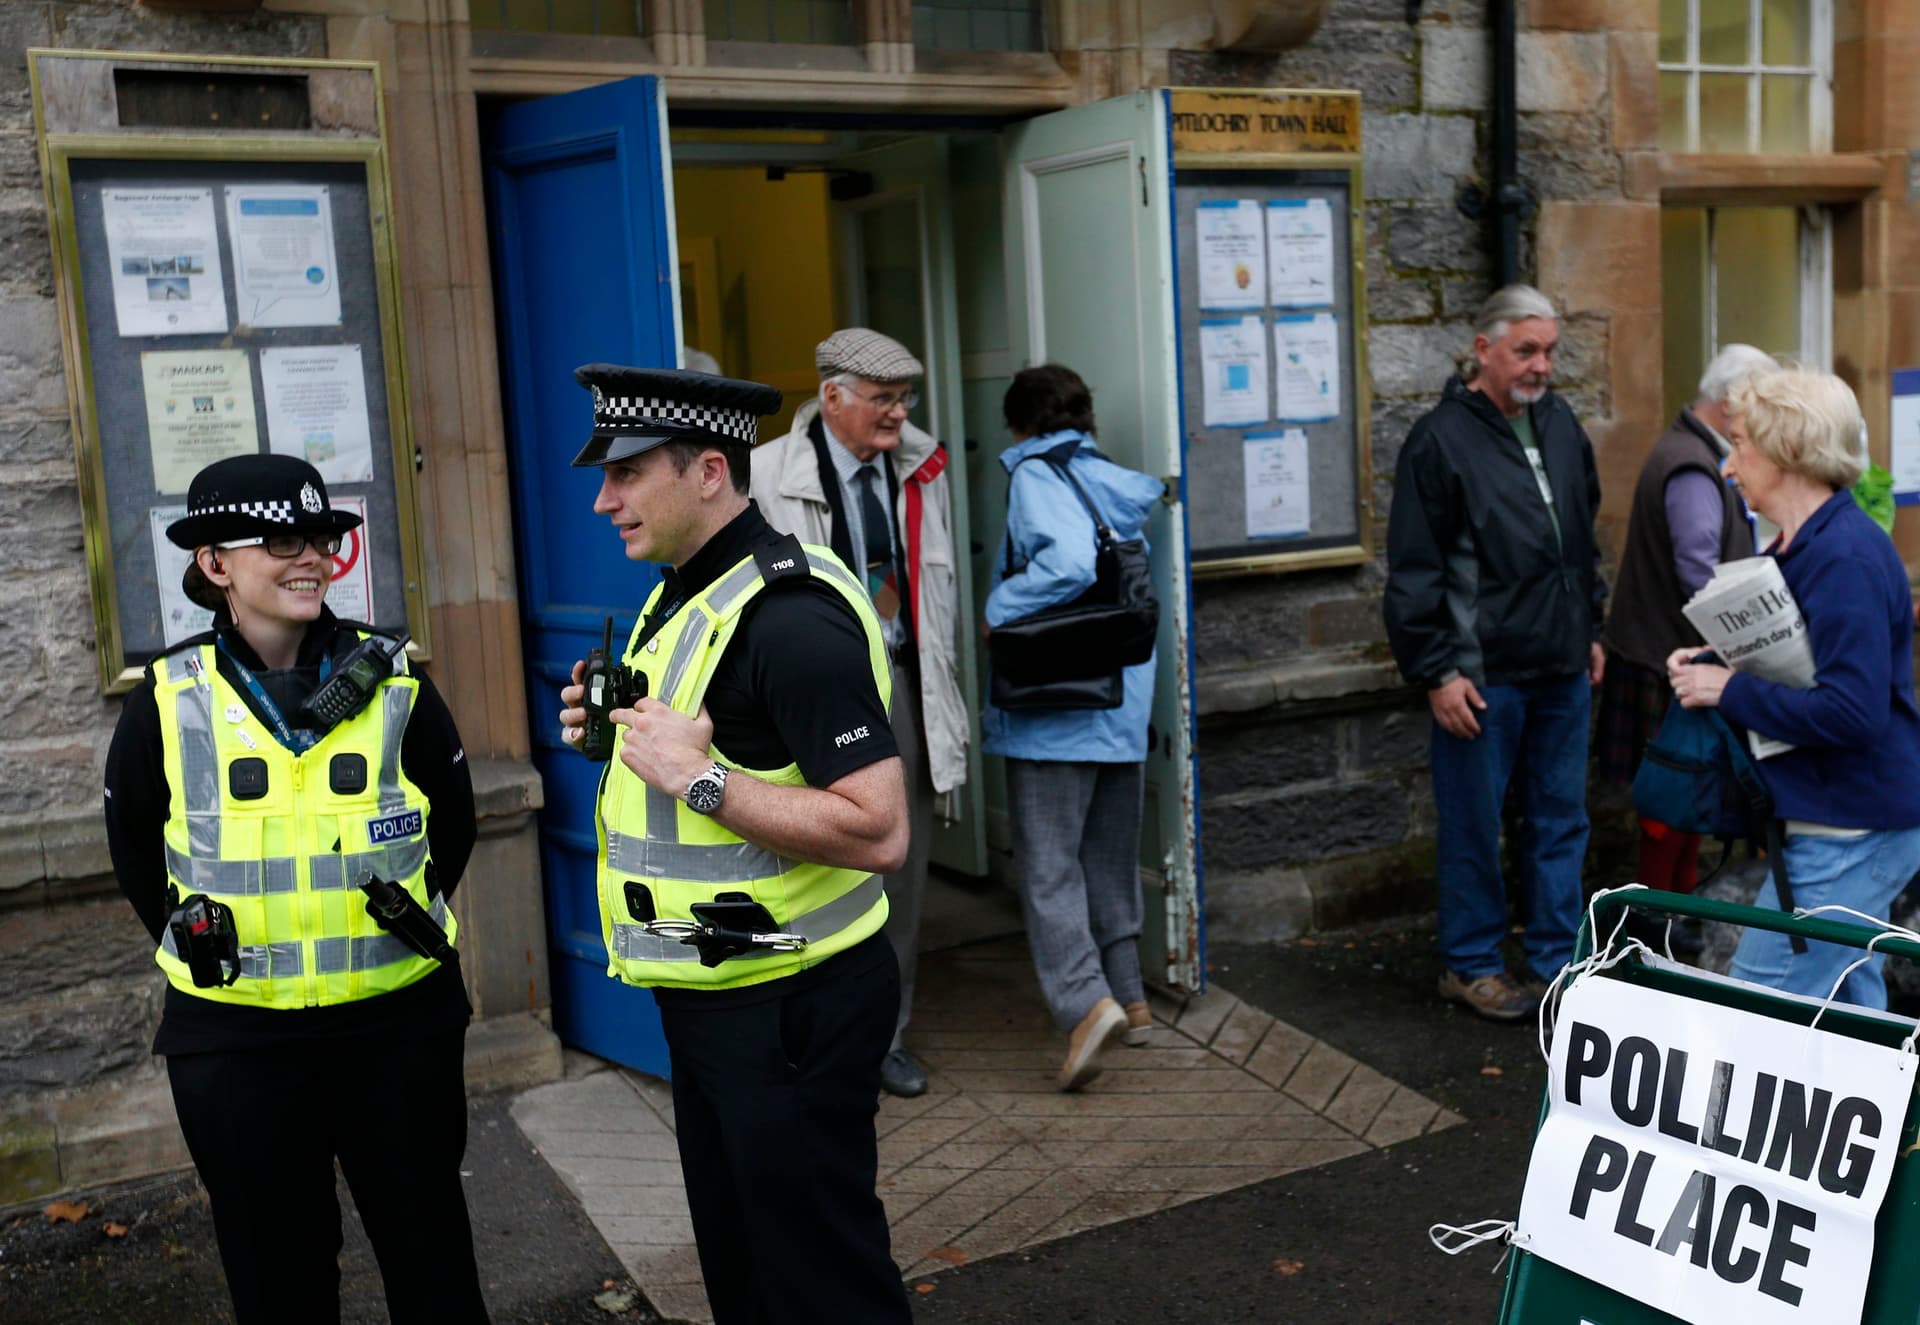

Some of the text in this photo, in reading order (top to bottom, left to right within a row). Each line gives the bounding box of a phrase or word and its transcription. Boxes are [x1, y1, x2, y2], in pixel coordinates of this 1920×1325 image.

[1259, 113, 1307, 134] TOWN
[1312, 114, 1347, 134] HALL
[771, 558, 795, 572] 1108
[1715, 607, 1754, 634] The
[1770, 625, 1793, 643] day
[835, 725, 870, 748] POLICE
[372, 815, 420, 840] POLICE
[1565, 1021, 1882, 1199] POLLING
[1569, 1134, 1816, 1307] PLACE
